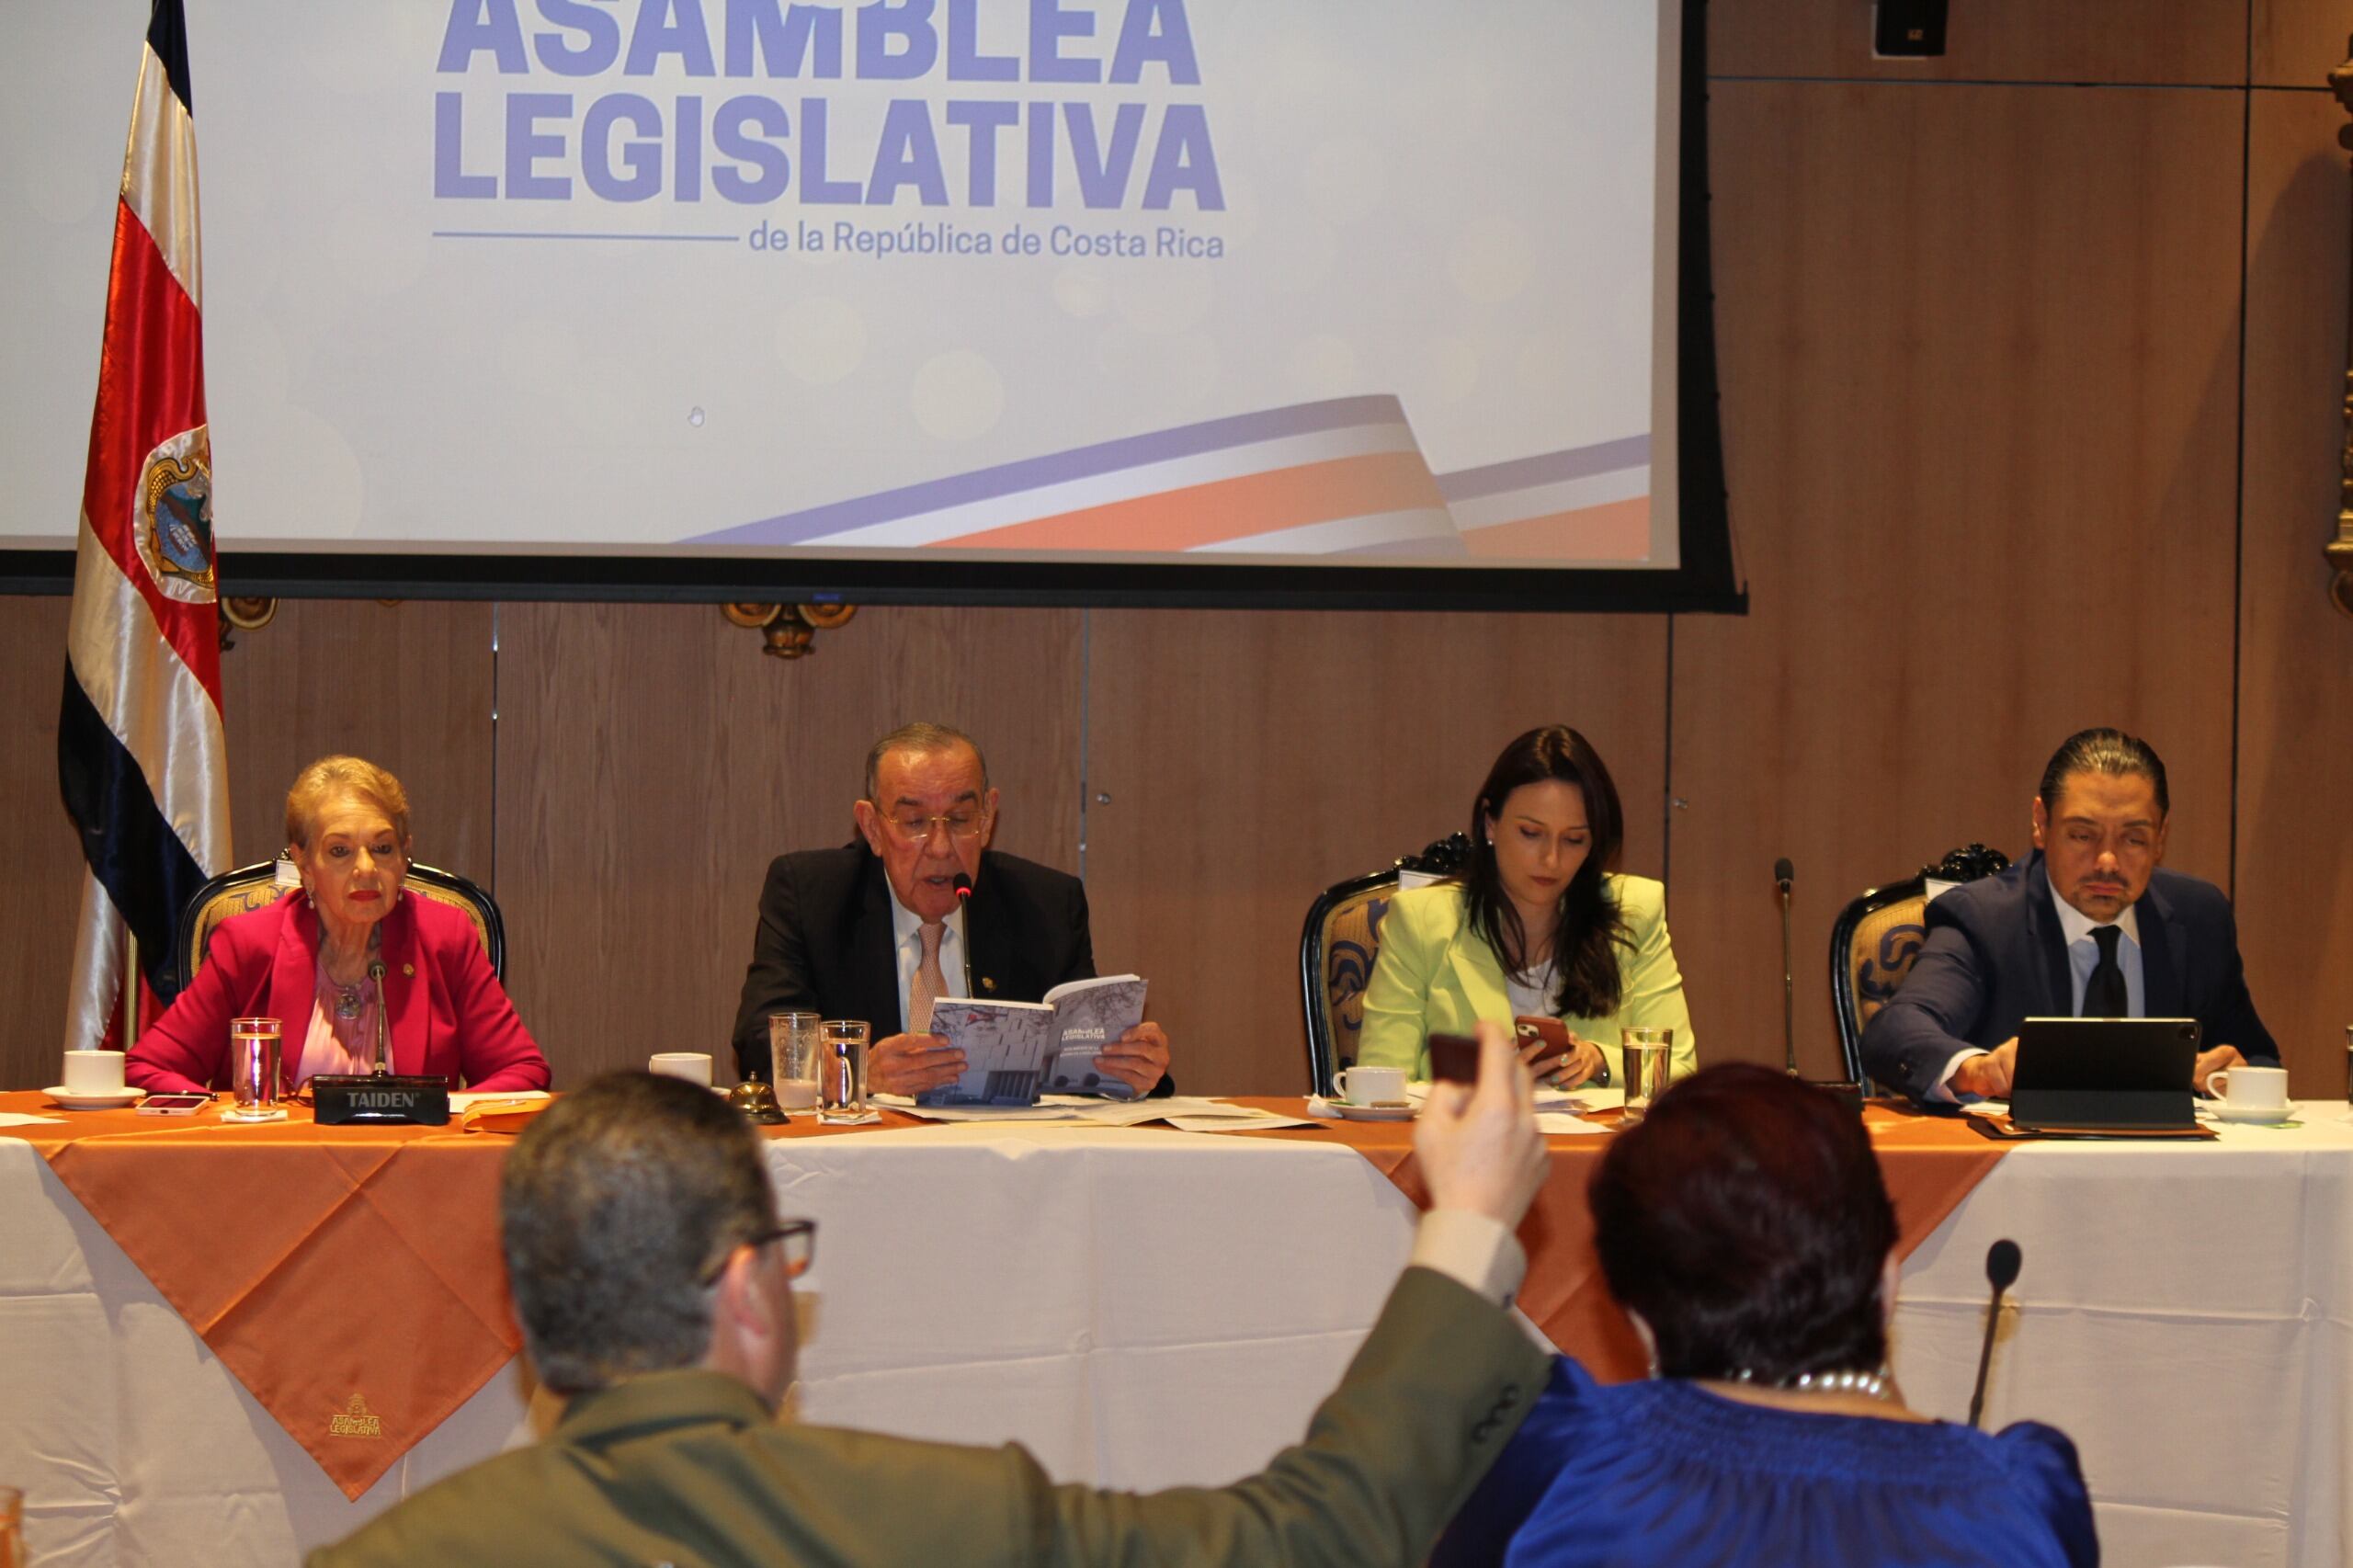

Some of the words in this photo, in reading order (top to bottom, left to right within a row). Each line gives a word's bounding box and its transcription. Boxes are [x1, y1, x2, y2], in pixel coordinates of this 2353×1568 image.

[436, 0, 1201, 85] ASAMBLEA
[433, 92, 1227, 211] LEGISLATIVA
[749, 220, 789, 251] de
[798, 220, 824, 251] la
[833, 222, 993, 259] República
[1002, 223, 1041, 256] de
[1050, 224, 1146, 256] Costa
[1155, 228, 1224, 258] Rica
[347, 1092, 415, 1108] TAIDEN
[330, 1426, 381, 1435] LEGISLATIVA
